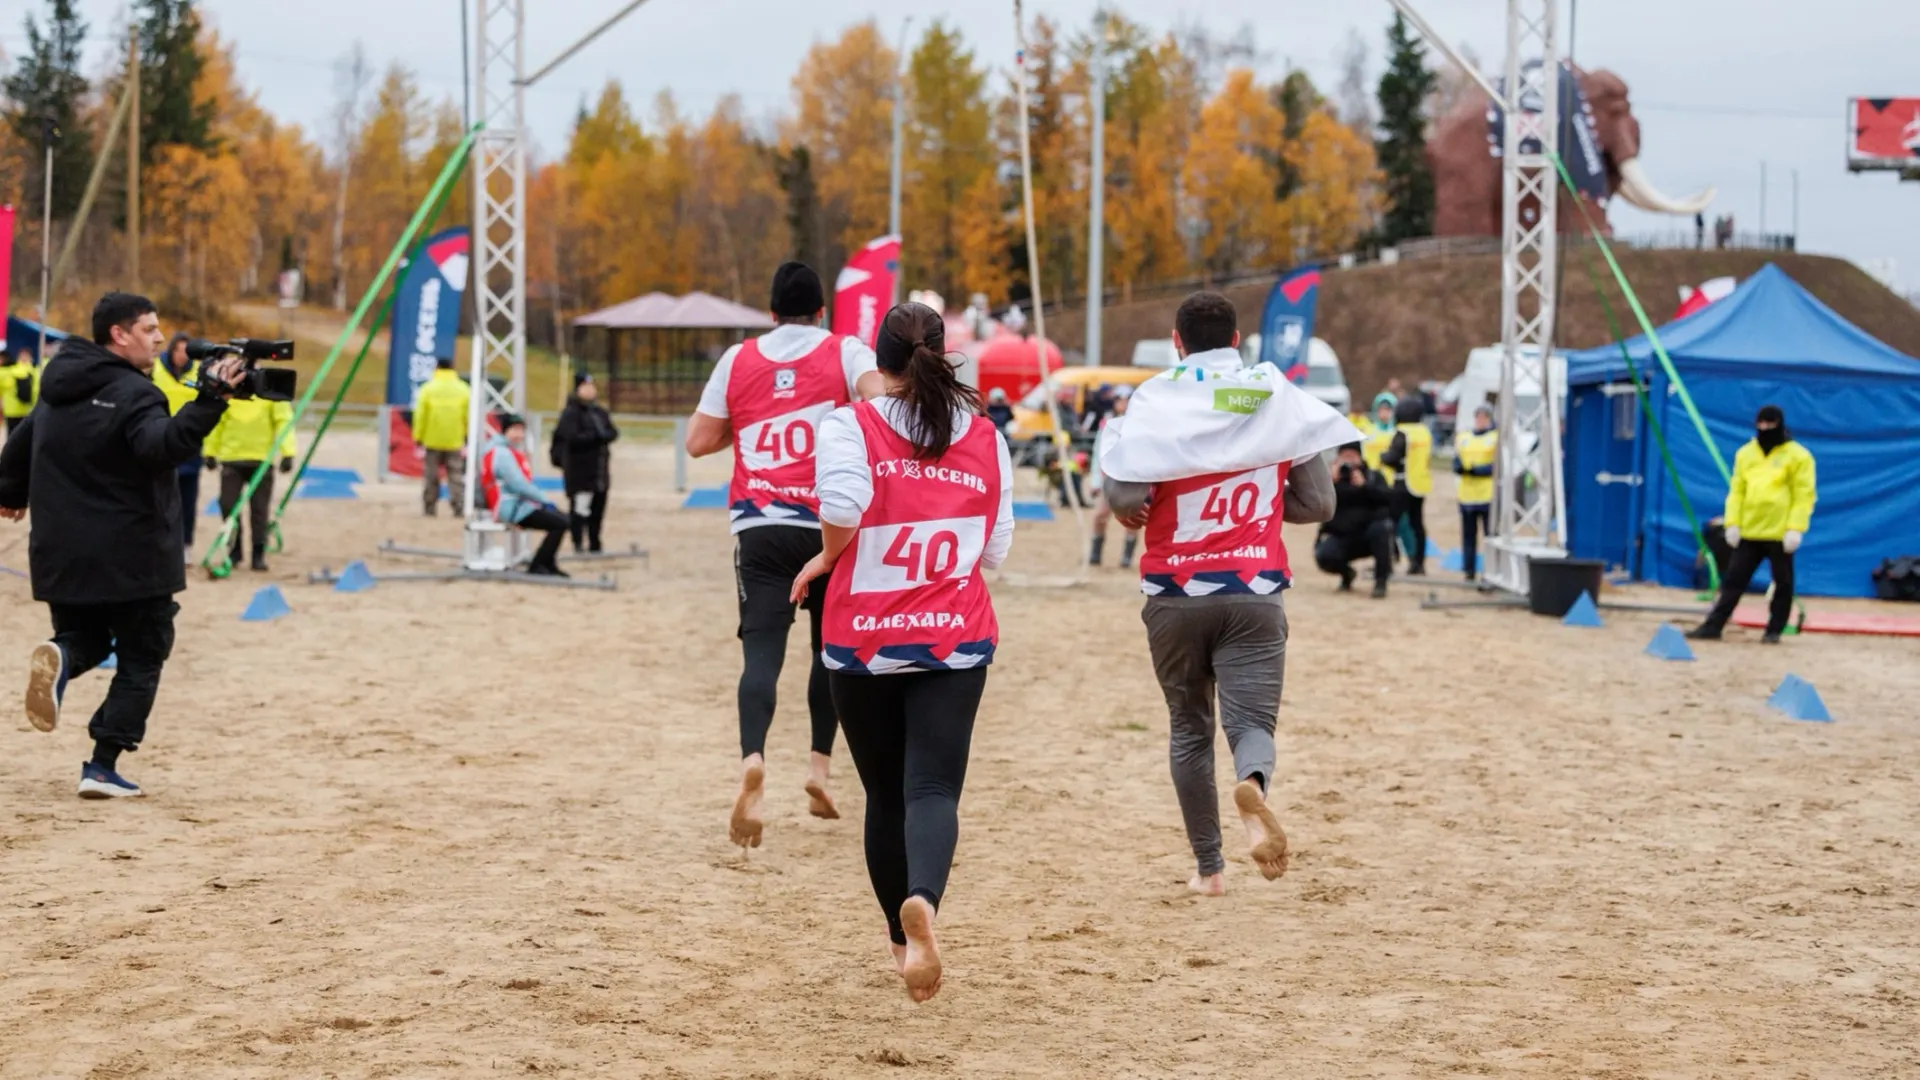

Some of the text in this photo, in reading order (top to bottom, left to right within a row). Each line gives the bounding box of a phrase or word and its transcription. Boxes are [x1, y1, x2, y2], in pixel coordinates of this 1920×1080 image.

[755, 419, 815, 461] 40
[876, 459, 987, 495] СХ ОСЕНЬ
[1200, 482, 1259, 526] 40
[882, 525, 959, 582] 40
